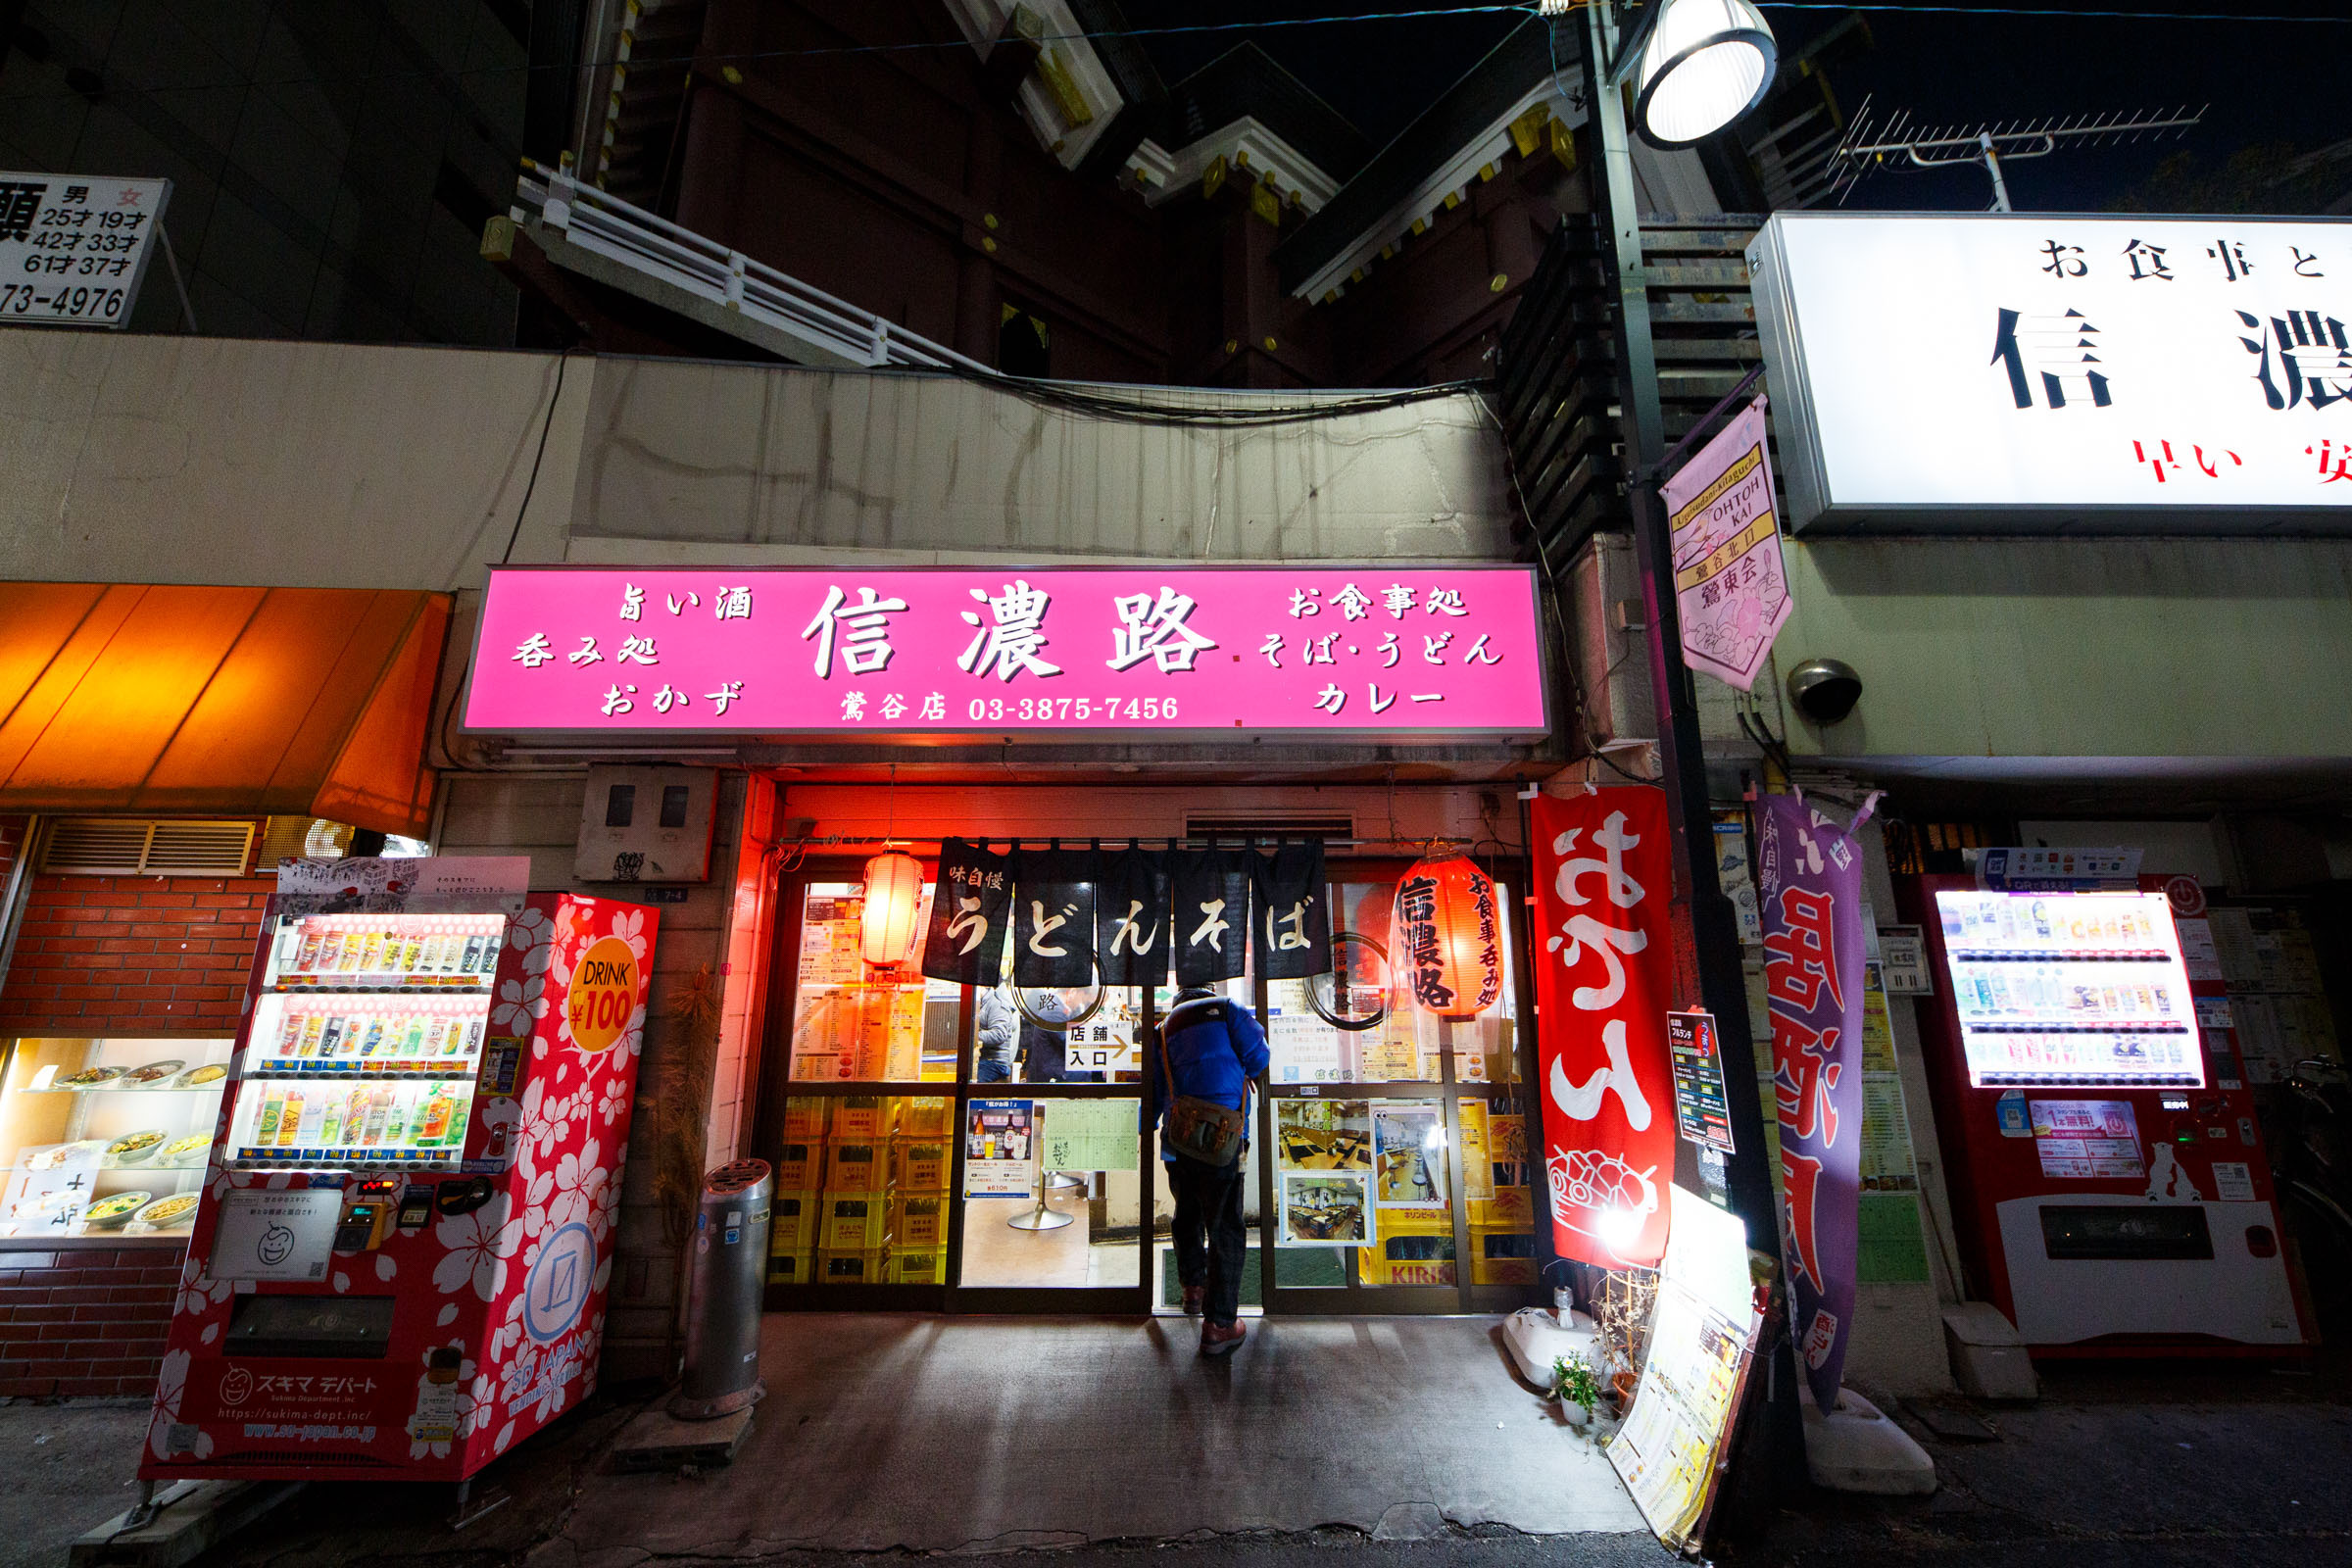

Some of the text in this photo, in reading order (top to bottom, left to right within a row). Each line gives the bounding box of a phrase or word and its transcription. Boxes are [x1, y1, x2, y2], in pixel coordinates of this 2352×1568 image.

[63, 186, 143, 207] 男 女
[41, 209, 147, 229] 25才 19才
[32, 232, 139, 253] 42才 33才
[24, 255, 130, 276] 61才 37才
[2040, 239, 2325, 282] お食事と
[2132, 439, 2242, 483] 早い
[1713, 476, 1760, 523] OHTOH
[1732, 503, 1753, 527] KAI
[619, 582, 753, 622] 旨い酒
[1288, 583, 1468, 621] お食事処
[801, 579, 1218, 683] 信濃路
[511, 632, 660, 668] 呑み処
[1258, 632, 1504, 668] そば・うどん
[601, 681, 744, 716] おかず
[840, 691, 1178, 722] 鶯谷店 03-3875-7456
[1312, 681, 1445, 715] カレー
[949, 866, 1004, 891] 味自慢
[947, 895, 1314, 957] うどんそば
[1396, 876, 1454, 1008] 信濃路
[583, 959, 630, 988] DRINK
[1070, 1026, 1107, 1042] 店舗
[1070, 1051, 1107, 1065] 入口
[1392, 1265, 1454, 1284] KIRIN
[257, 1375, 376, 1394] スキマ デパート
[218, 1407, 372, 1422] https://sukima-dept.inc/
[243, 1424, 376, 1443] www.so-japan.co.jp
